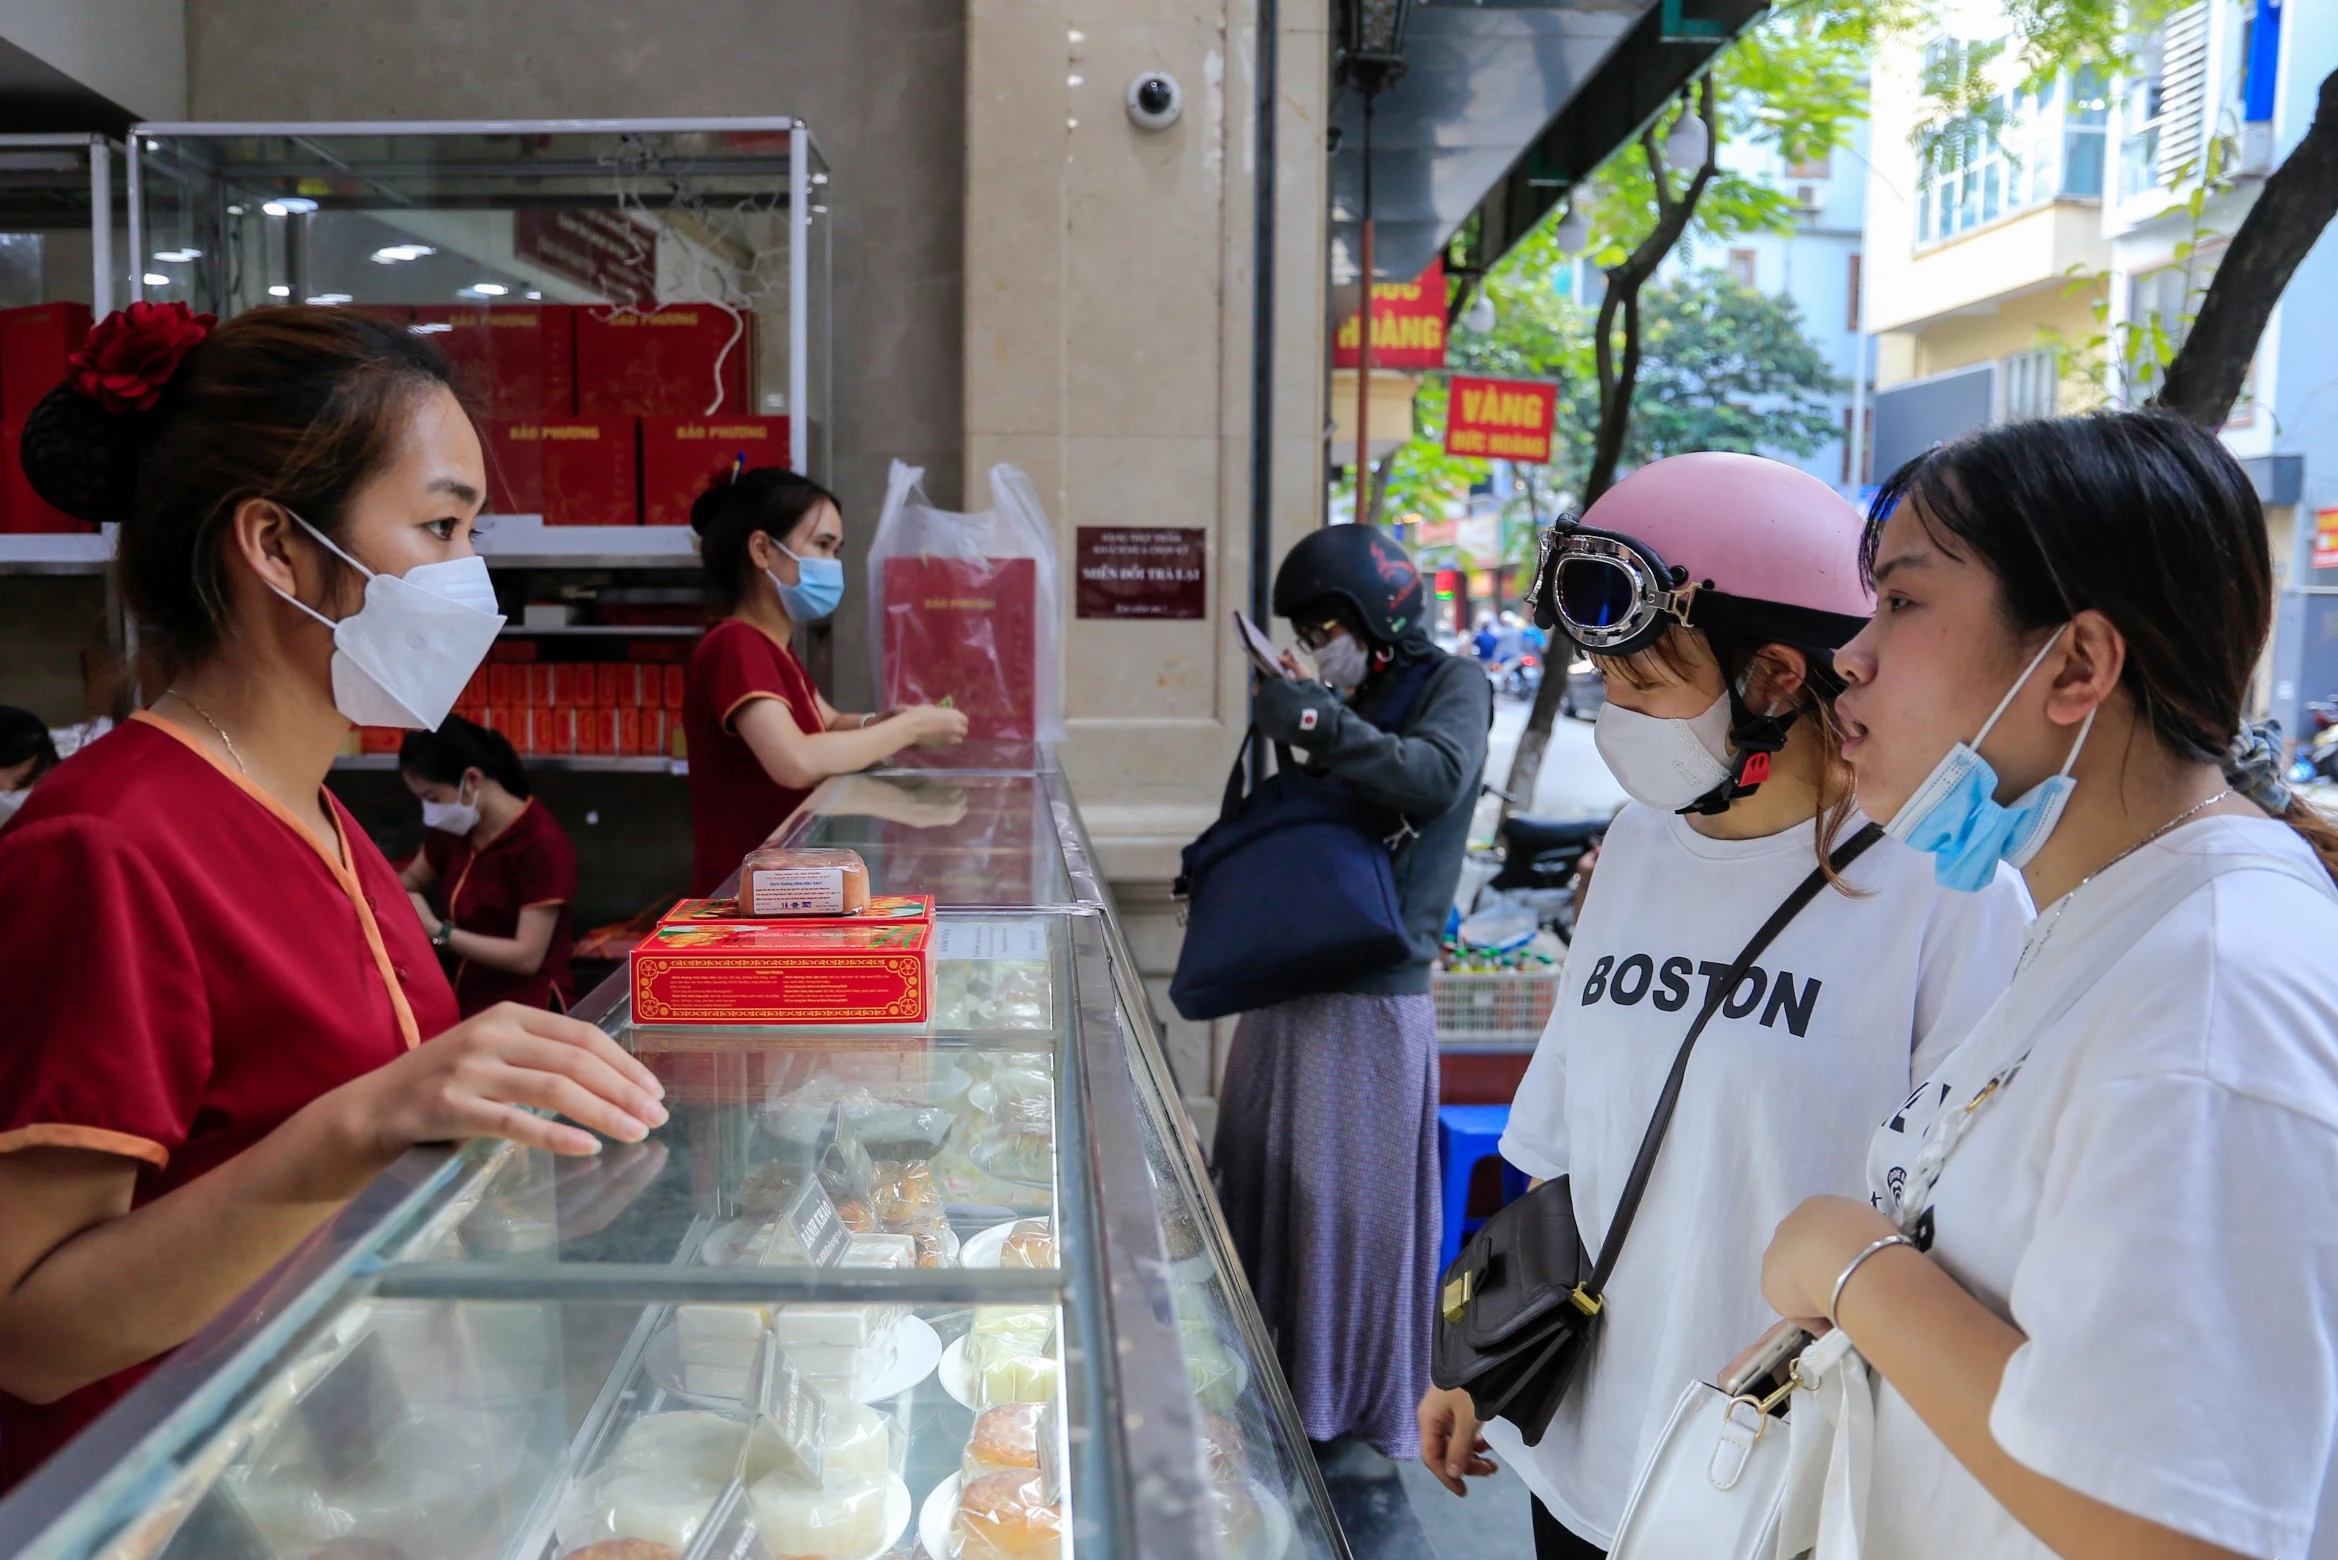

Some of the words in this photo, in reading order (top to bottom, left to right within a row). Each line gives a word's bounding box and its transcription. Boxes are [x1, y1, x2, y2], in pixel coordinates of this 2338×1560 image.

[1461, 384, 1543, 428] VÀNG
[509, 421, 539, 439] BẢO
[542, 425, 600, 439] PHƯƠNG
[676, 421, 706, 439] BẢO
[709, 425, 768, 439] PHƯƠNG
[1451, 428, 1485, 452] ĐỨC
[1488, 431, 1548, 458] HOÀNG
[1119, 562, 1145, 580] ĐỔI
[1581, 953, 1823, 1038] BOSTON
[800, 1217, 821, 1250] BÁNH
[813, 1198, 832, 1230] KHẢO
